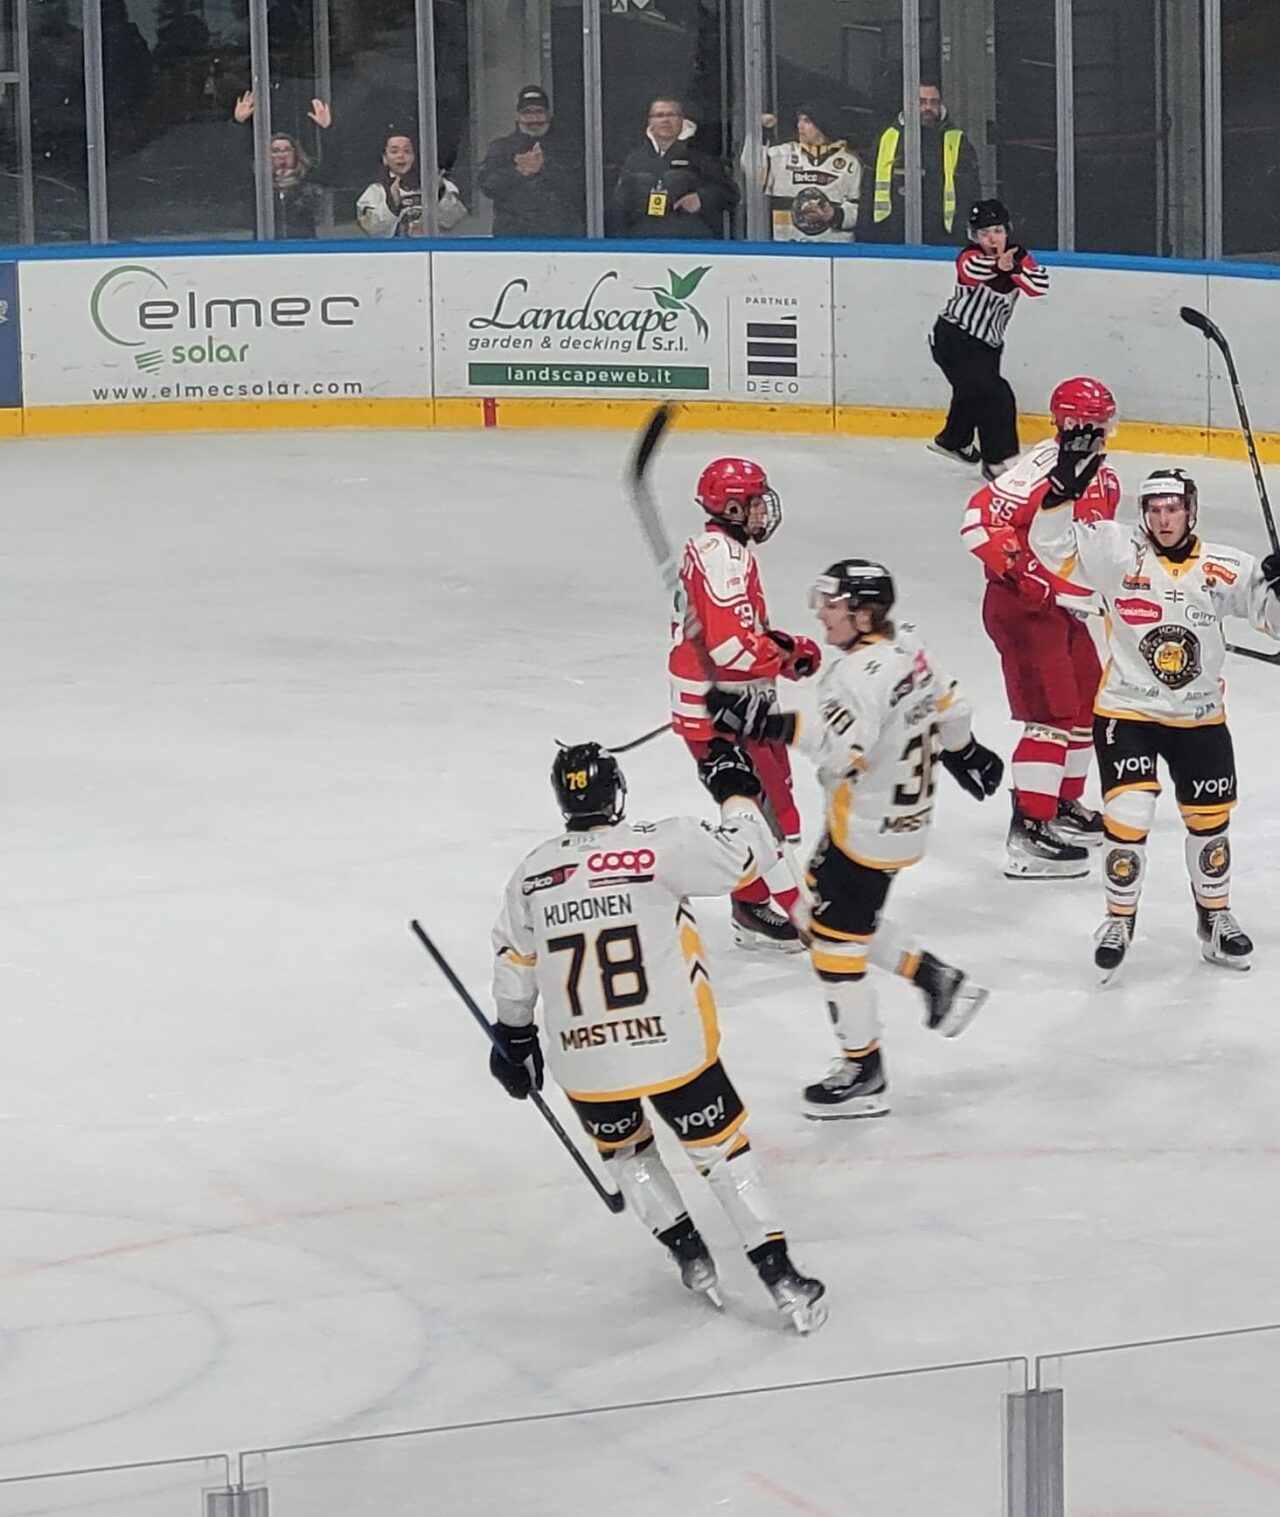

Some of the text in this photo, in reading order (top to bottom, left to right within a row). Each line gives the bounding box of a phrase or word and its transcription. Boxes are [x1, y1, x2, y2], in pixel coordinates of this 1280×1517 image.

[138, 291, 360, 330] elmec
[468, 270, 679, 351] Landscape
[745, 296, 798, 307] PARTNER
[171, 335, 249, 364] solar
[468, 334, 689, 353] garden & decking S.r.l.
[506, 366, 672, 385] landscapeweb.it
[92, 380, 363, 401] www.elmecsolar.com
[566, 770, 587, 790] 78
[1113, 755, 1155, 780] yop!
[1192, 775, 1234, 799] yop!
[586, 849, 657, 874] coop
[543, 893, 633, 928] KURONEN
[546, 924, 649, 1018] 78
[559, 1015, 667, 1052] MASTINI
[586, 1111, 638, 1136] yop!
[674, 1095, 726, 1135] yop!
